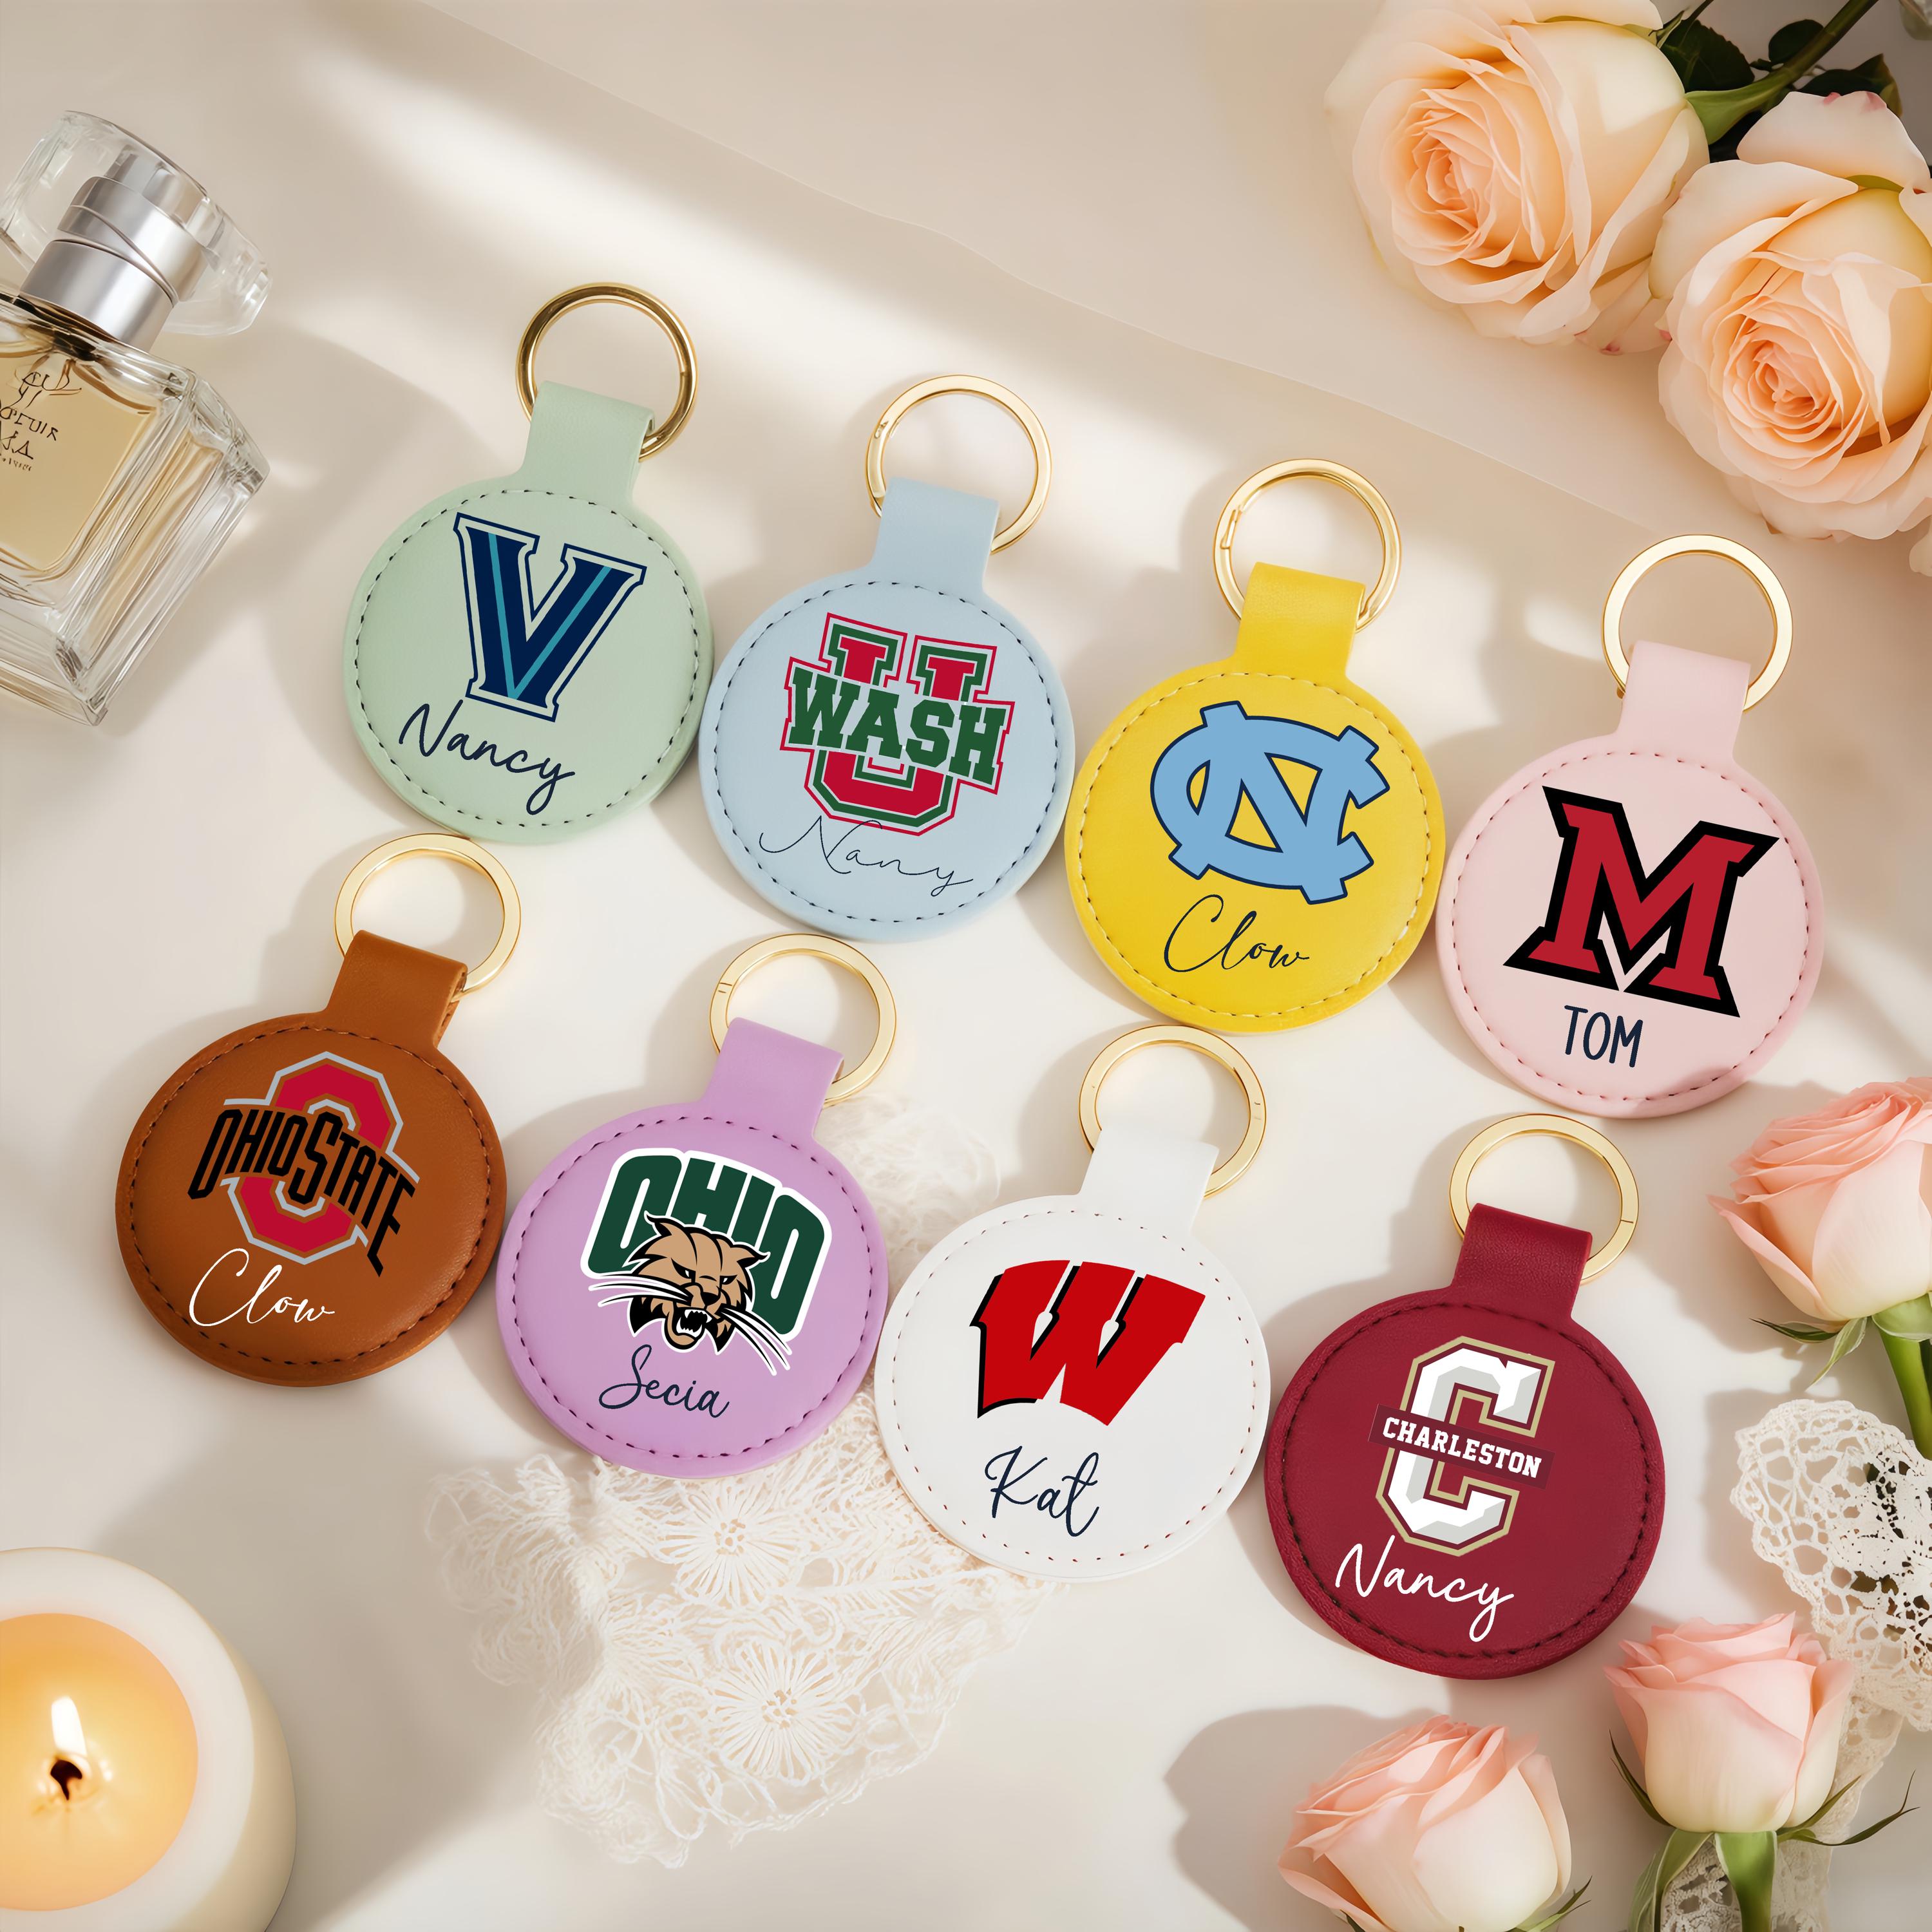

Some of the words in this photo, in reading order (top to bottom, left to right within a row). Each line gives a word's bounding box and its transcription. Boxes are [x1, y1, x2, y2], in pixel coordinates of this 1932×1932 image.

[453, 512, 647, 723] V
[399, 699, 575, 815] Nancy
[788, 667, 1007, 785] WASH
[1164, 894, 1309, 972] Clow
[1502, 785, 1780, 1018] M
[1564, 1005, 1643, 1068] TOM
[187, 1109, 308, 1200] OHIO
[288, 1111, 415, 1277] STATE
[583, 1151, 829, 1339] OHIO
[189, 1248, 335, 1327] Clow
[969, 1260, 1206, 1426] W
[598, 1344, 730, 1417] Secia
[985, 1446, 1099, 1537] Kat
[1382, 1417, 1542, 1478] CHARLESTON
[1335, 1535, 1515, 1642] Nancy
